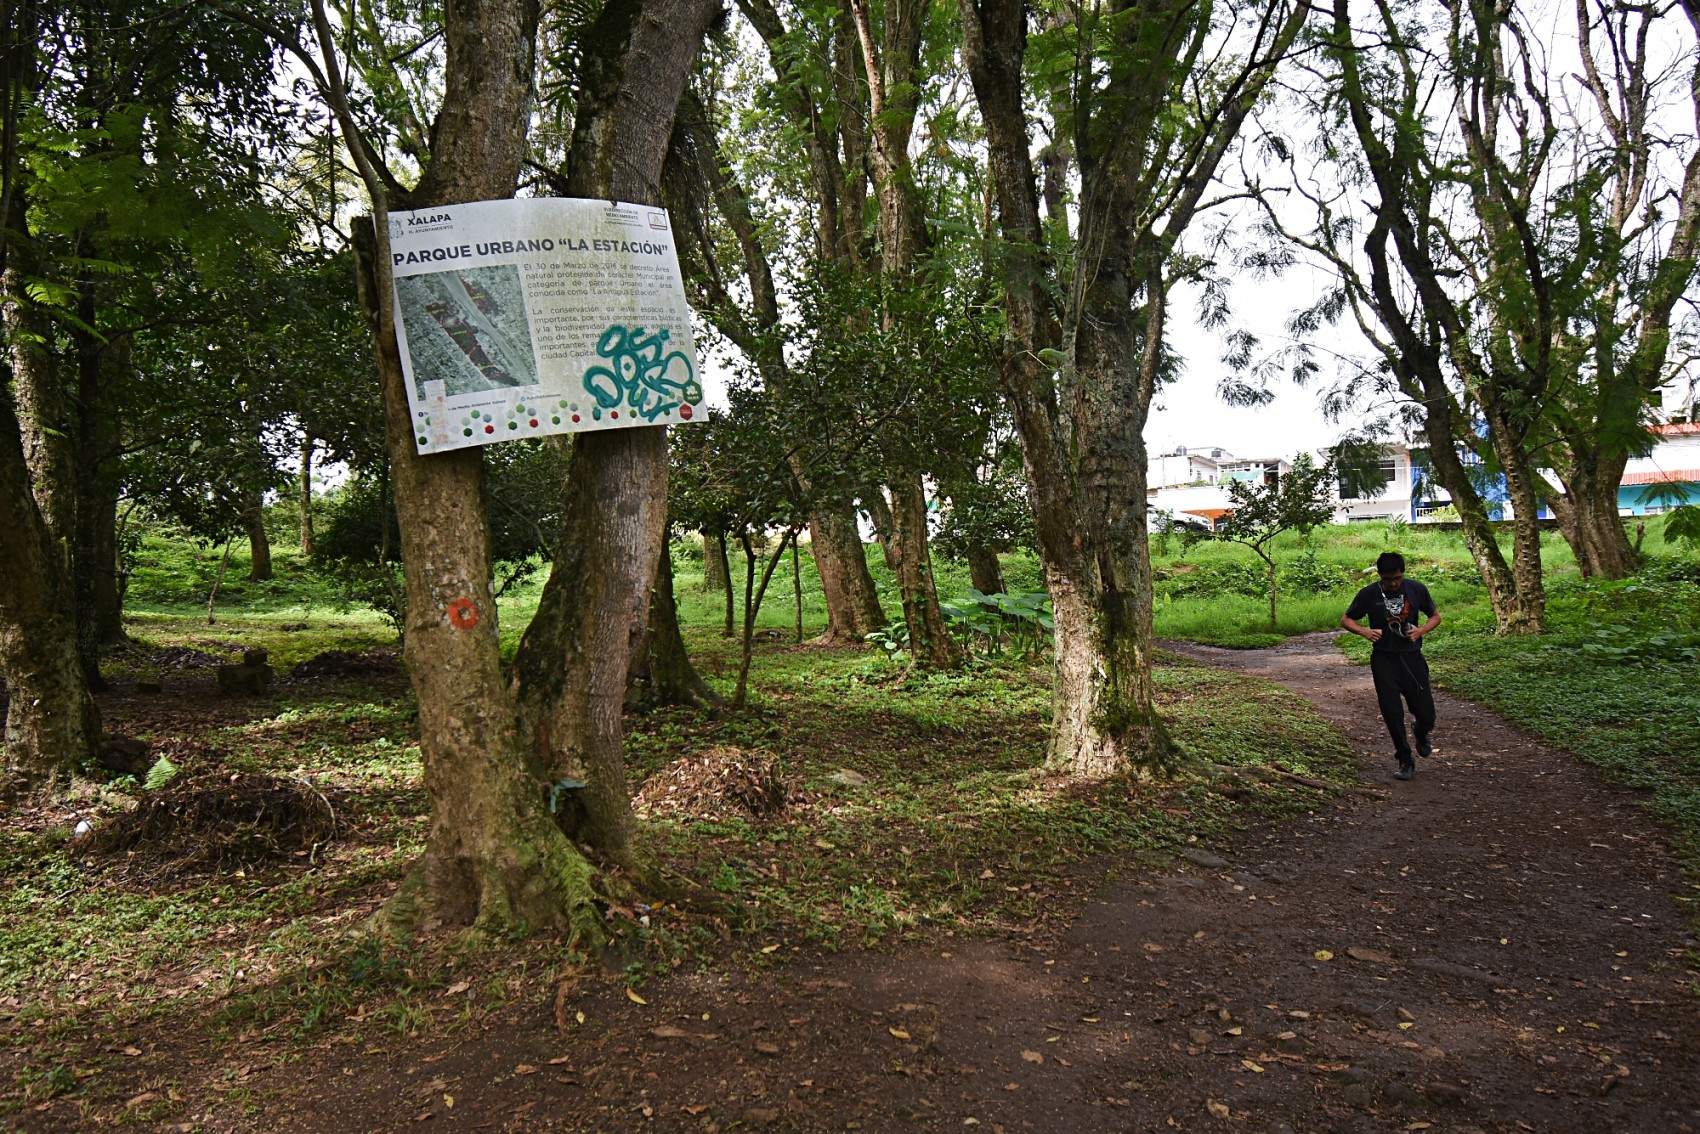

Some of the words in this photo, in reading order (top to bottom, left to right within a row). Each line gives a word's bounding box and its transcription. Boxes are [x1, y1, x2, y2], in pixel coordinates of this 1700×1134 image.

[407, 213, 452, 226] XALAPA
[415, 225, 453, 234] AYUNTAMIENTO
[393, 245, 472, 266] PARQUE
[476, 239, 554, 256] URBANO
[523, 263, 532, 271] El
[536, 262, 547, 270] 30
[550, 262, 560, 270] de
[589, 262, 599, 270] de
[601, 262, 617, 270] 2016
[525, 271, 554, 280] natural
[557, 271, 593, 279] protegida
[636, 272, 665, 280] Municipal
[528, 289, 565, 297] conocida
[550, 306, 599, 314] conservación
[534, 315, 580, 324] importante,
[555, 323, 605, 332] biodiversidad
[540, 350, 568, 359] ciudad
